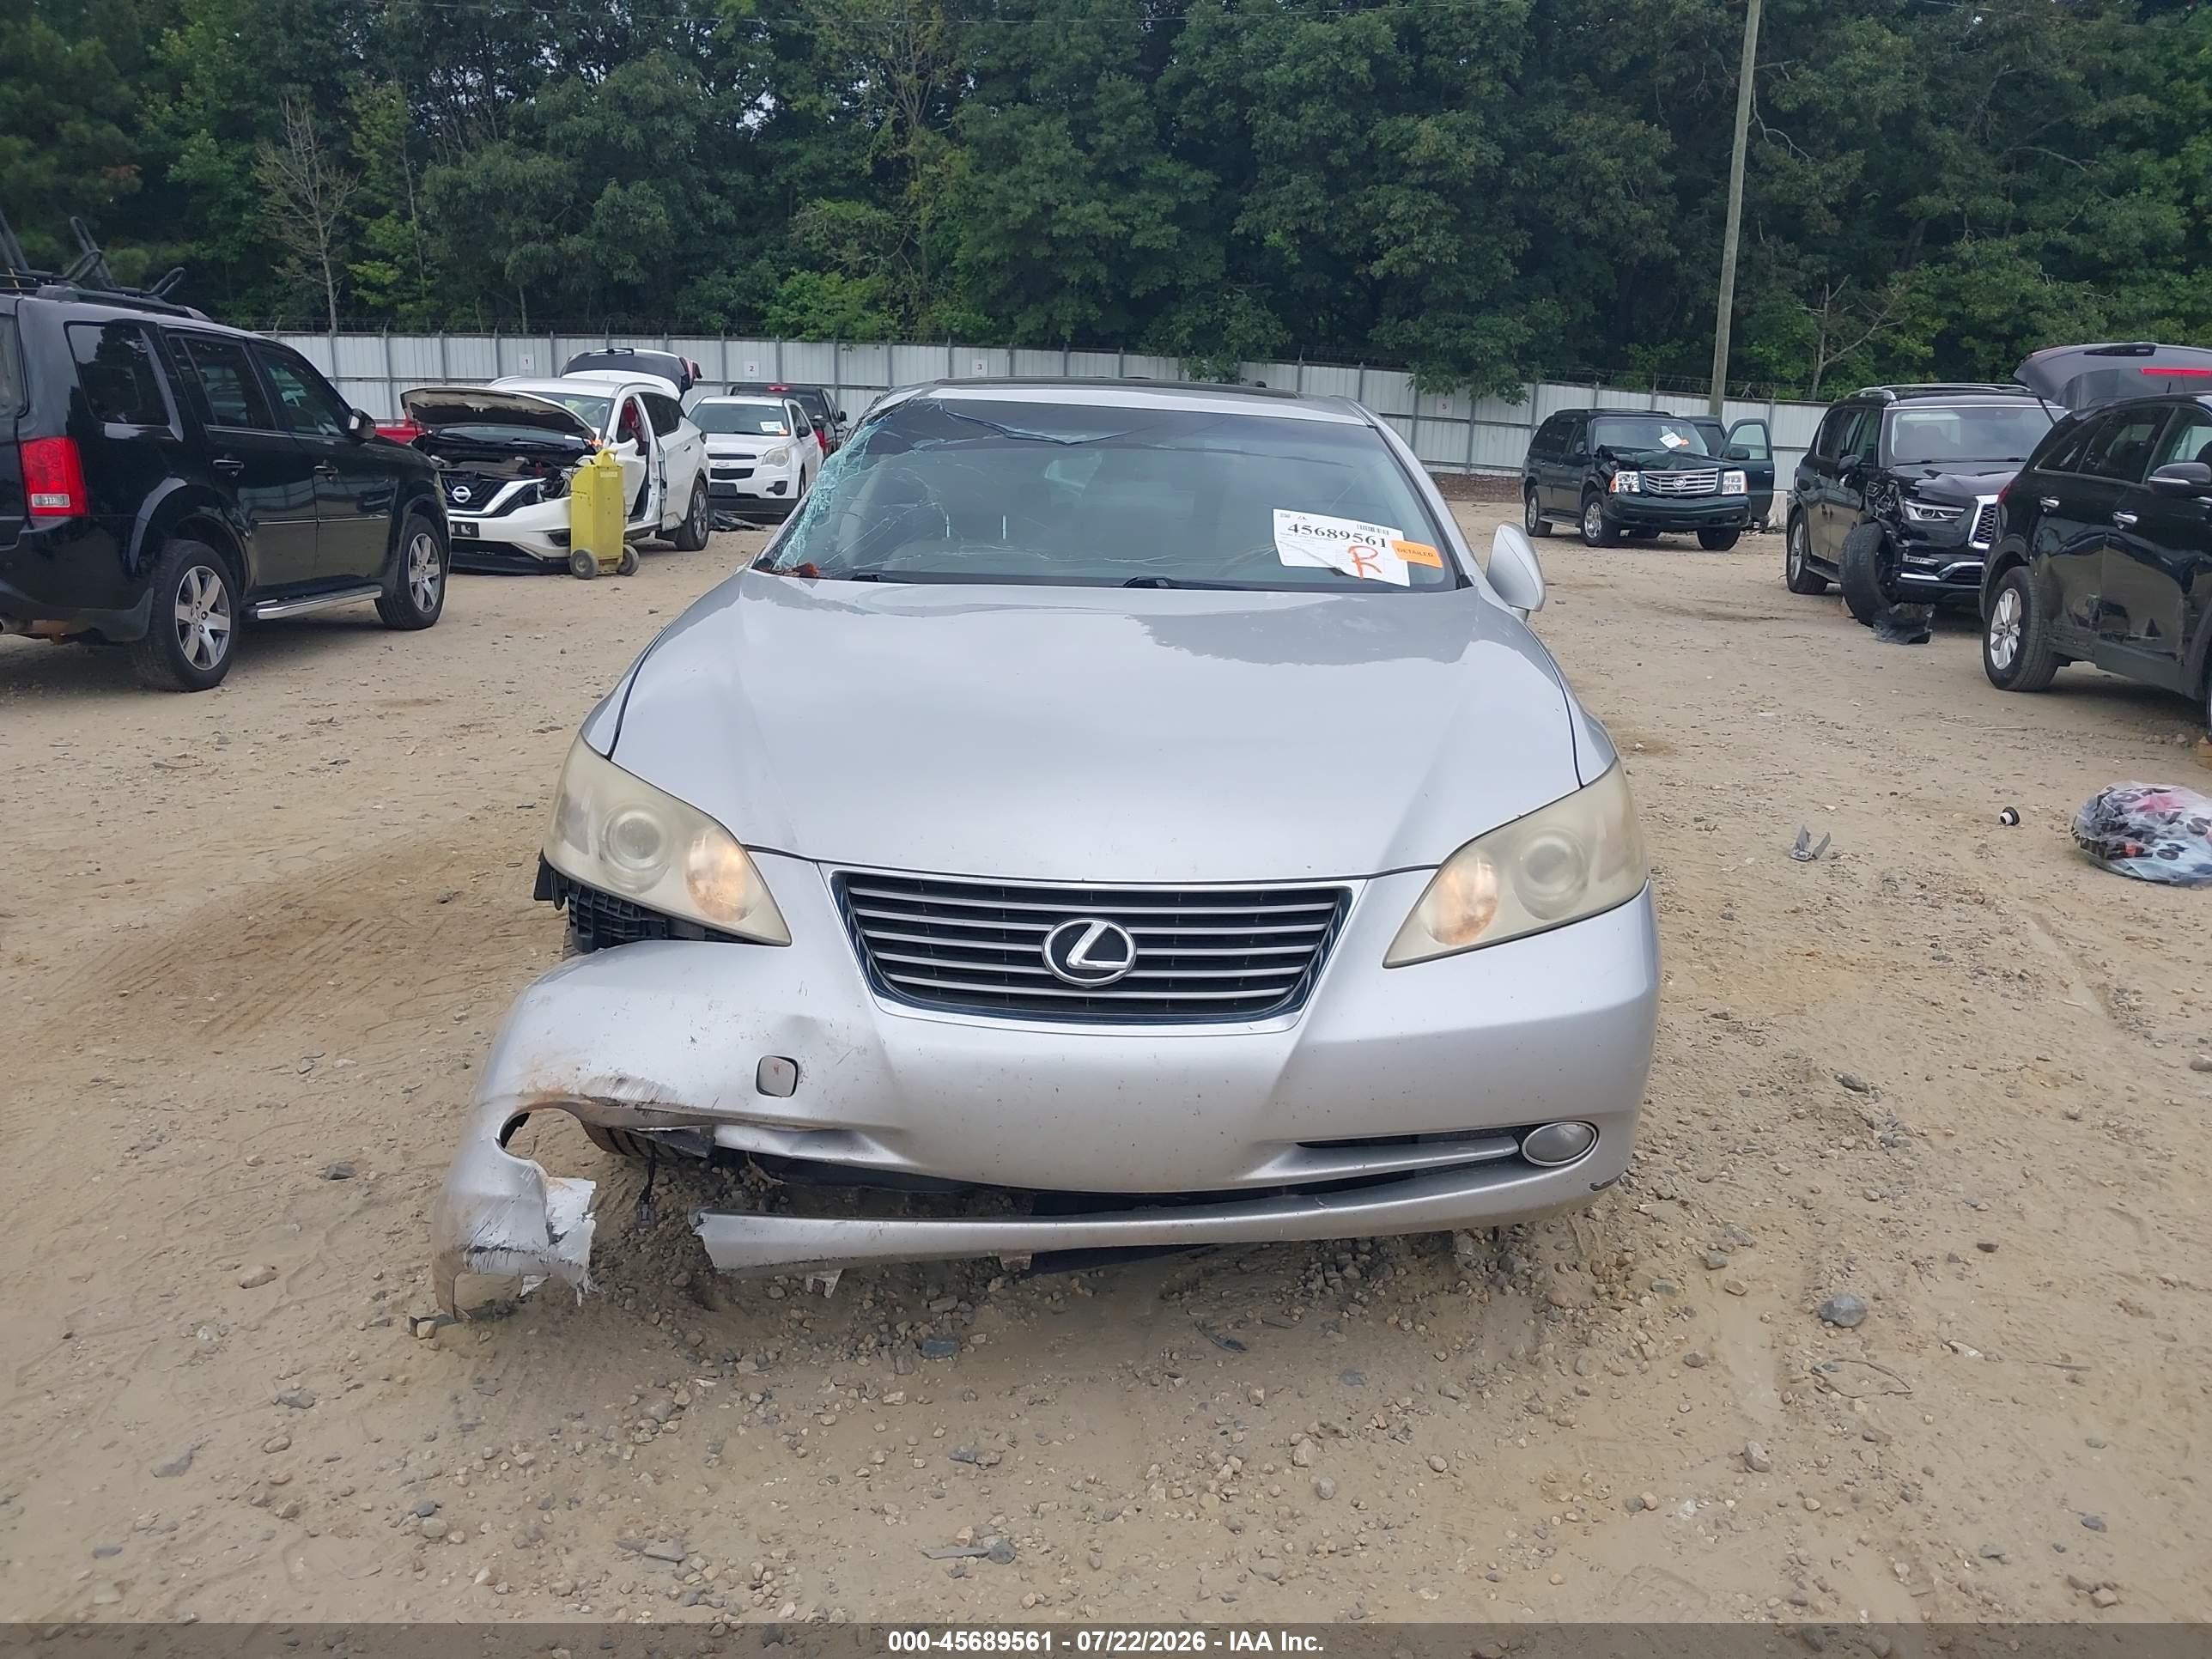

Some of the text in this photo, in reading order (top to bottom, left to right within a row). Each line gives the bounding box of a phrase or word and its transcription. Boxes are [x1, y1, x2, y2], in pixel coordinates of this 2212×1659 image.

[1287, 523, 1388, 549] 45689561
[1346, 544, 1383, 580] R
[1396, 547, 1435, 558] DETAILED
